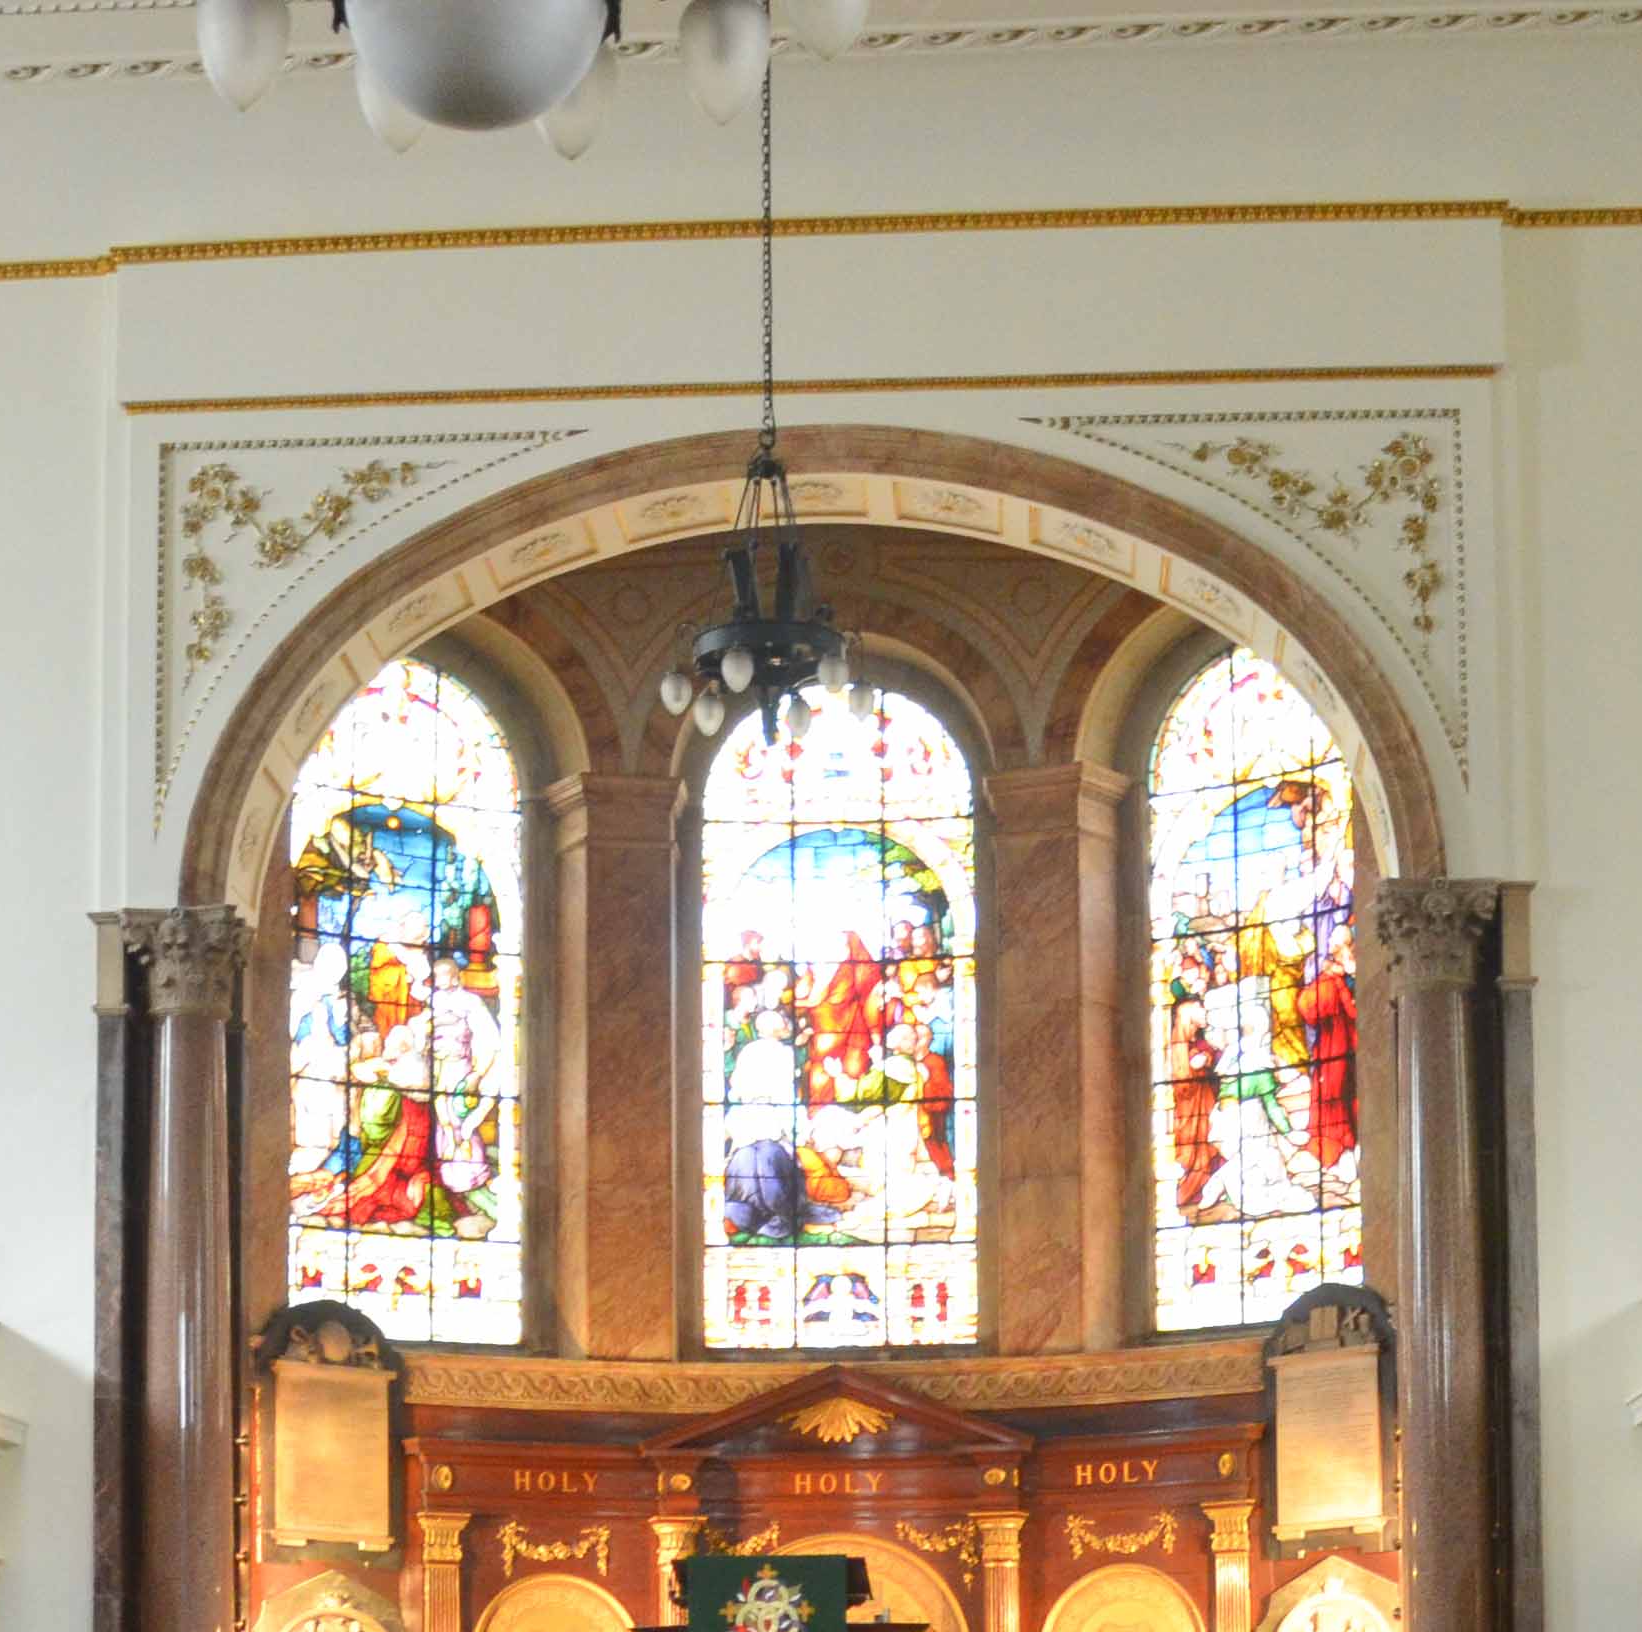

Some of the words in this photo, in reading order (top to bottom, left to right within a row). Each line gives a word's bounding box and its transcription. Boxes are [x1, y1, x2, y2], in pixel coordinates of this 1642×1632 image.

[514, 1470, 598, 1493] HOLY
[794, 1472, 883, 1495] HOLY
[1075, 1459, 1158, 1486] HOLY
